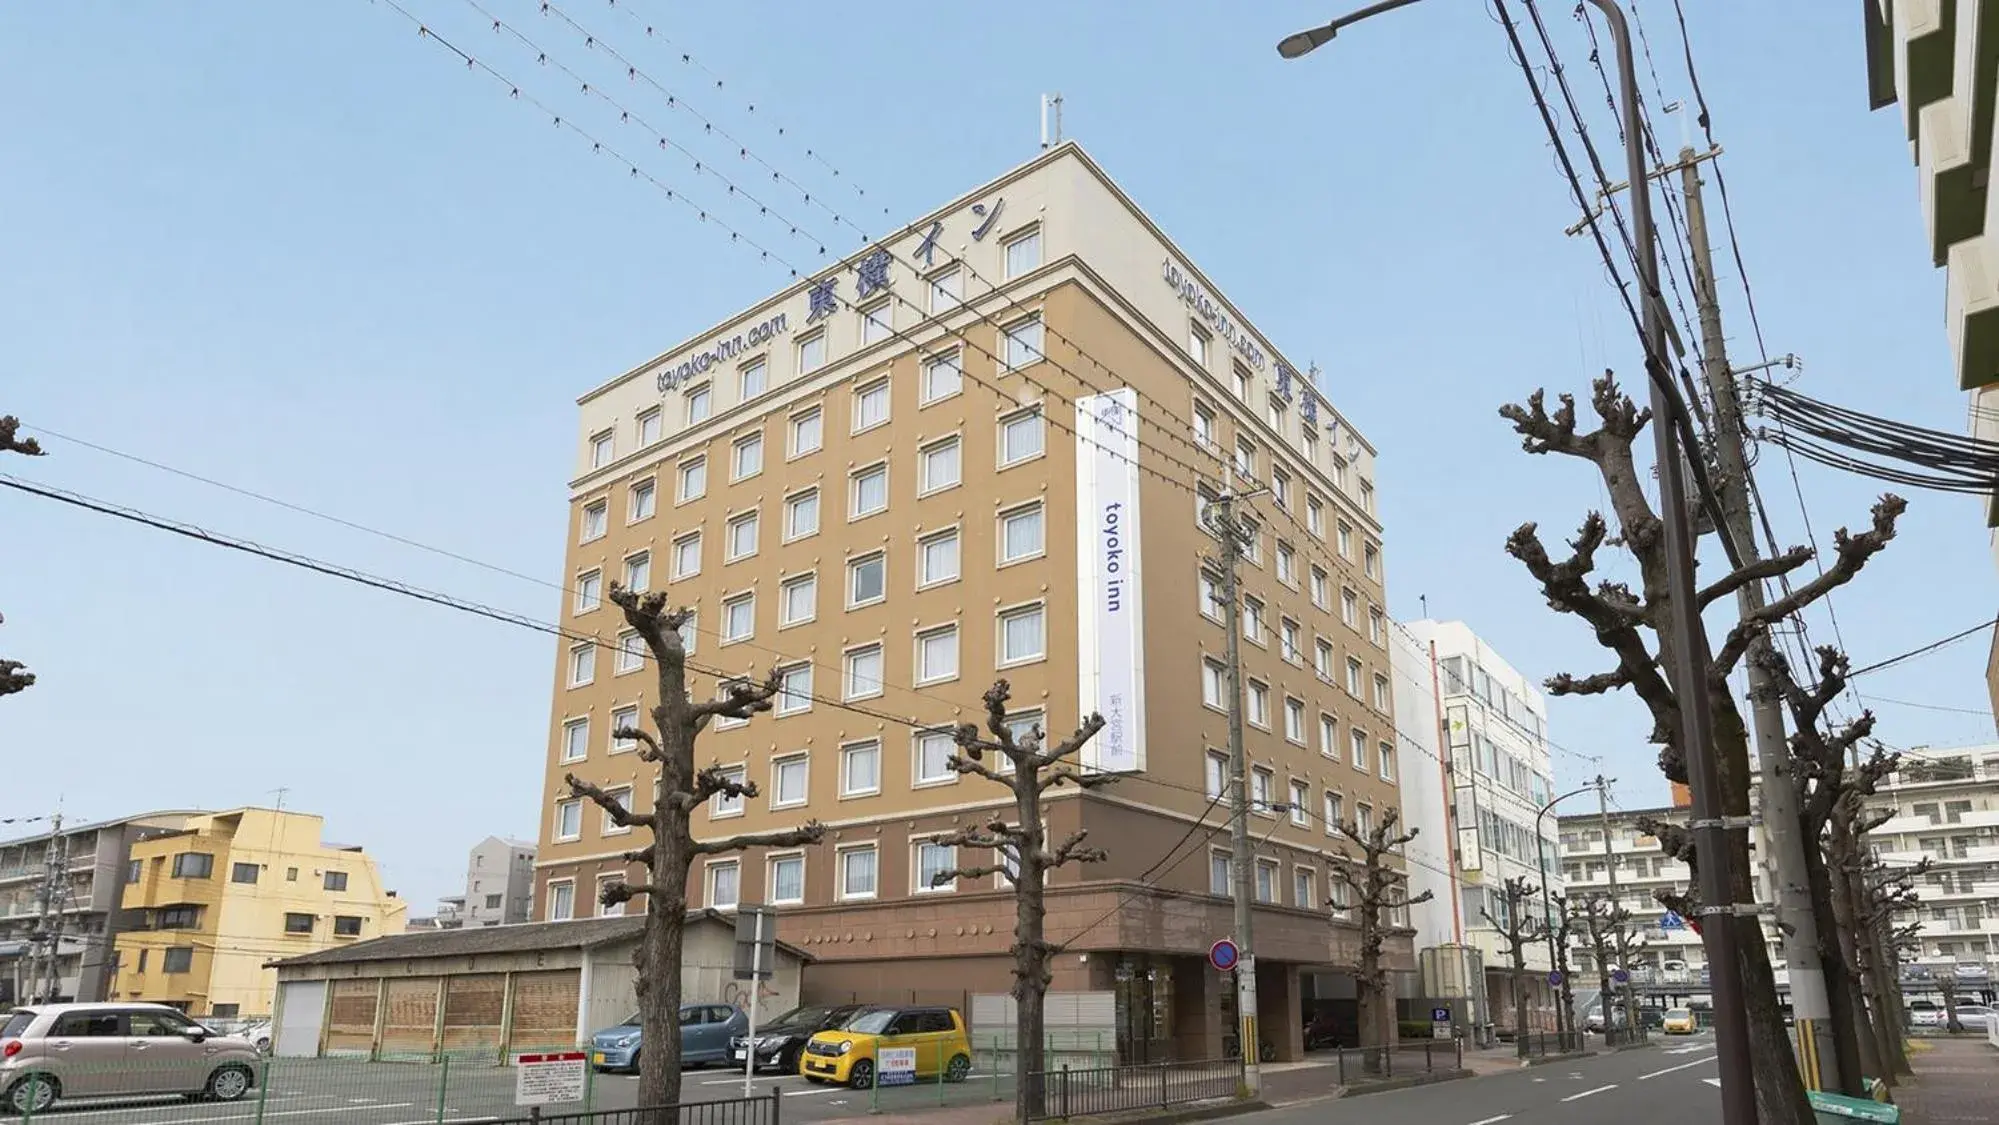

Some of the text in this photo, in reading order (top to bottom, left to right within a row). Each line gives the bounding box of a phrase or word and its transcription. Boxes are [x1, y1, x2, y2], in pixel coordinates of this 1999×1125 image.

[806, 197, 1005, 325] 東横イン
[1162, 257, 1266, 372] toyoko-inn.com
[656, 313, 788, 392] toyoko-inn.com
[1103, 502, 1123, 612] toyoko inn
[1435, 1009, 1447, 1020] P
